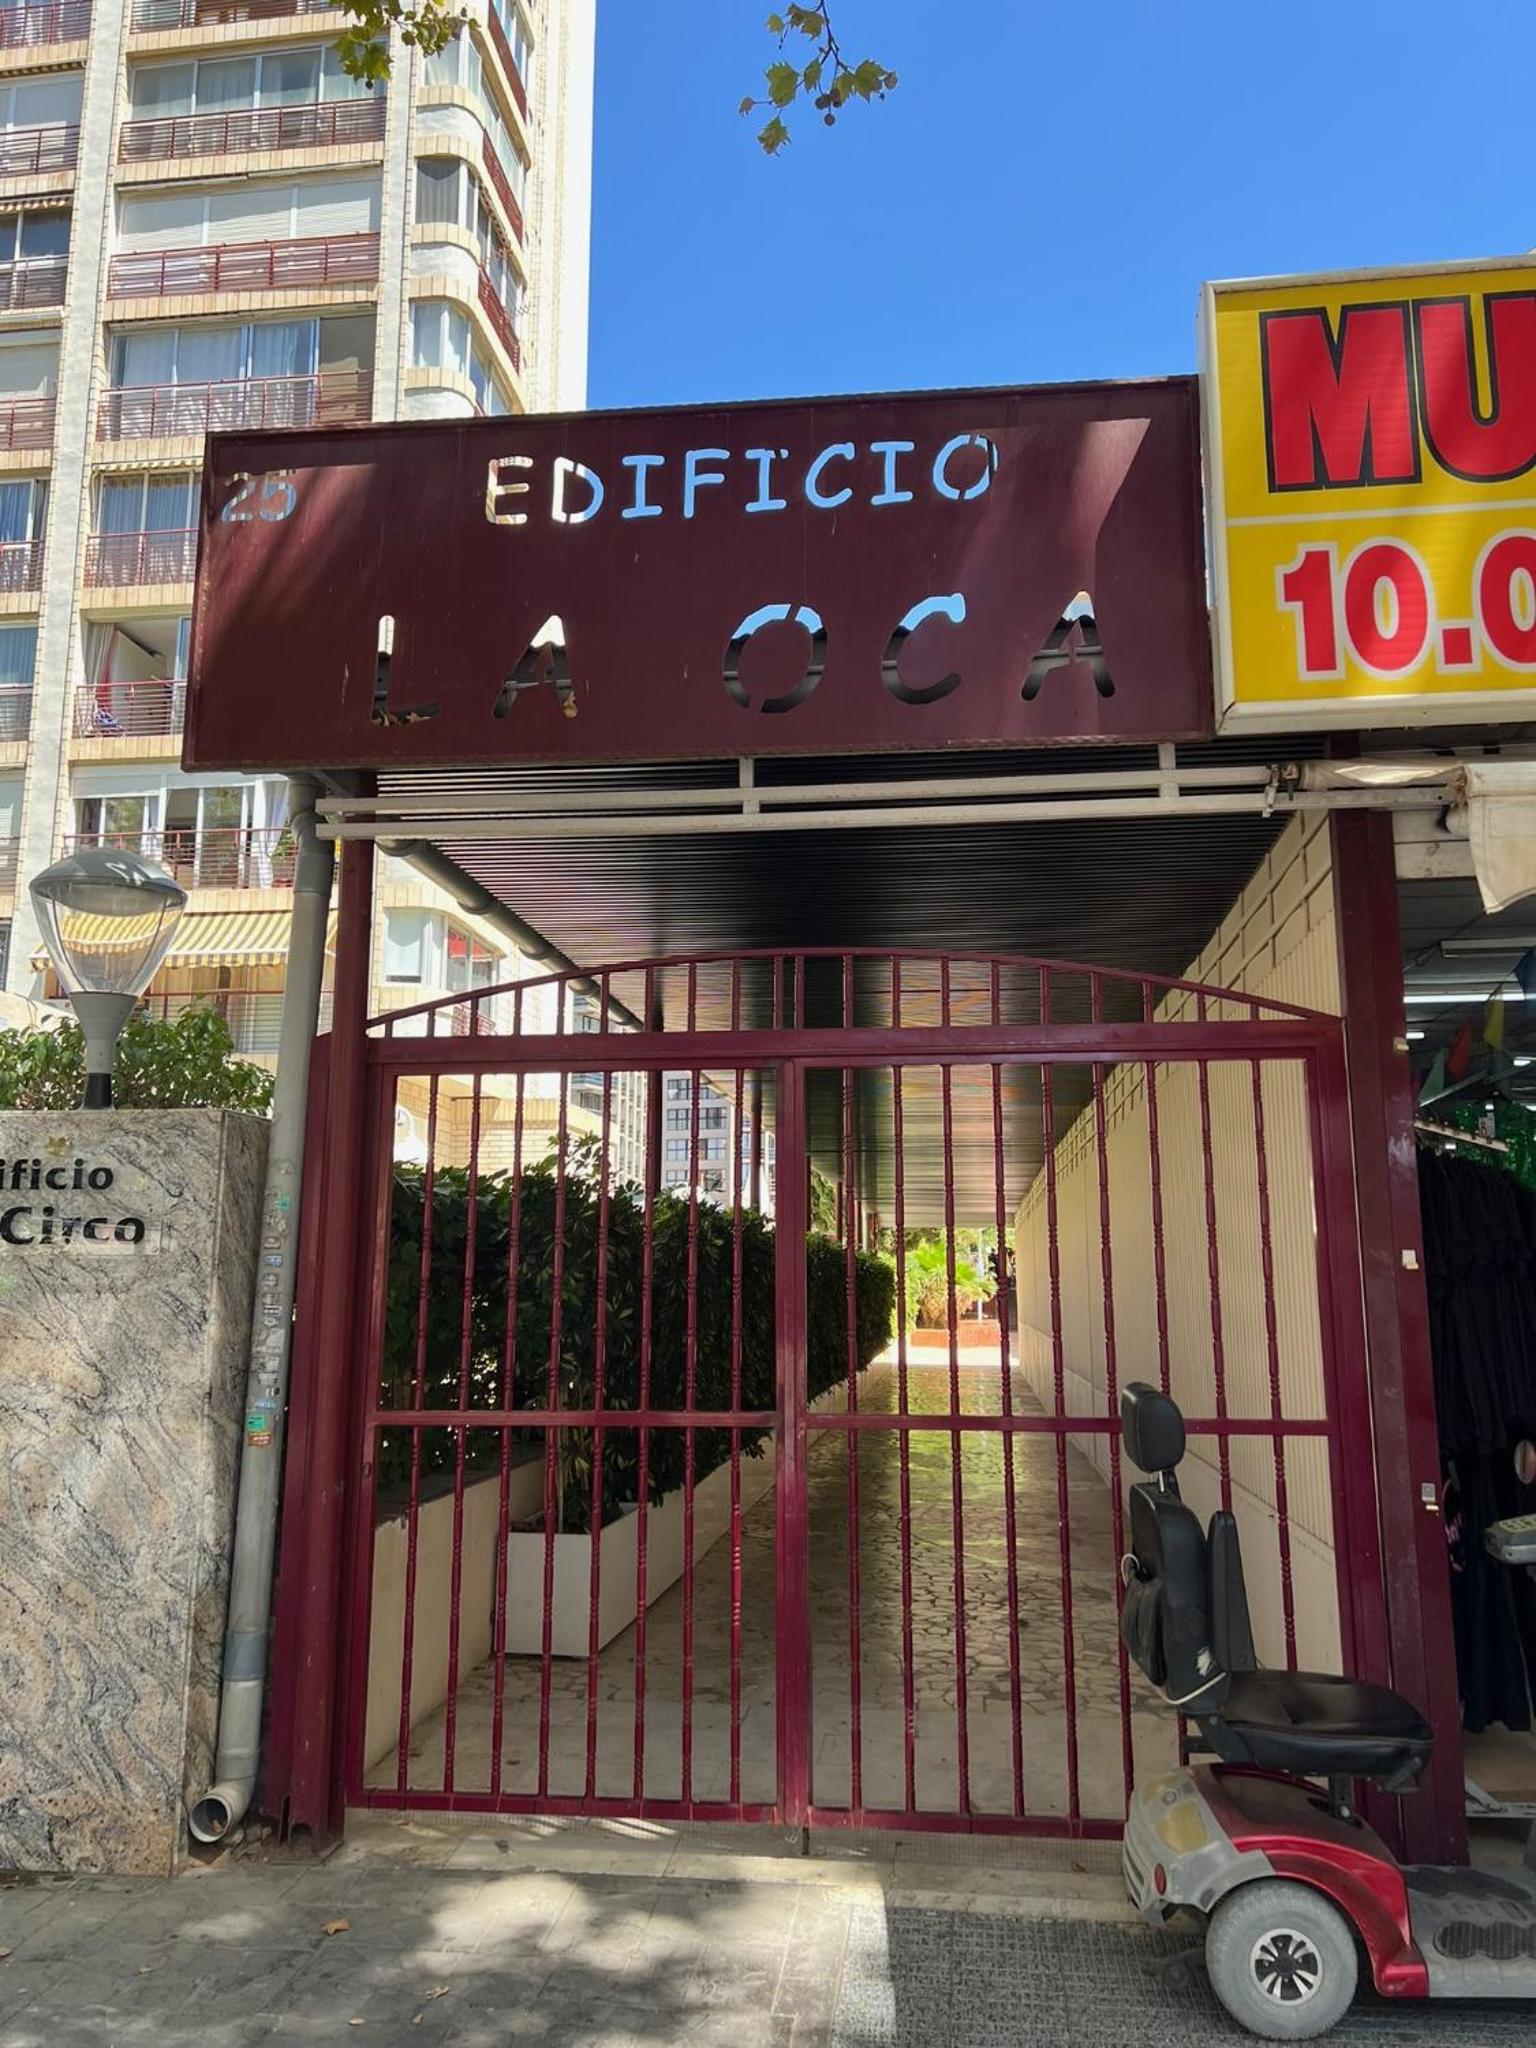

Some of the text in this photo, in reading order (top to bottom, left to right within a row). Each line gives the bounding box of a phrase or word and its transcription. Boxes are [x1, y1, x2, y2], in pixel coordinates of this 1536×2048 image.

[222, 467, 297, 523] 25
[485, 434, 997, 526] EDIFICIO
[370, 590, 1116, 727] LA OCA
[0, 1206, 146, 1245] Circo
